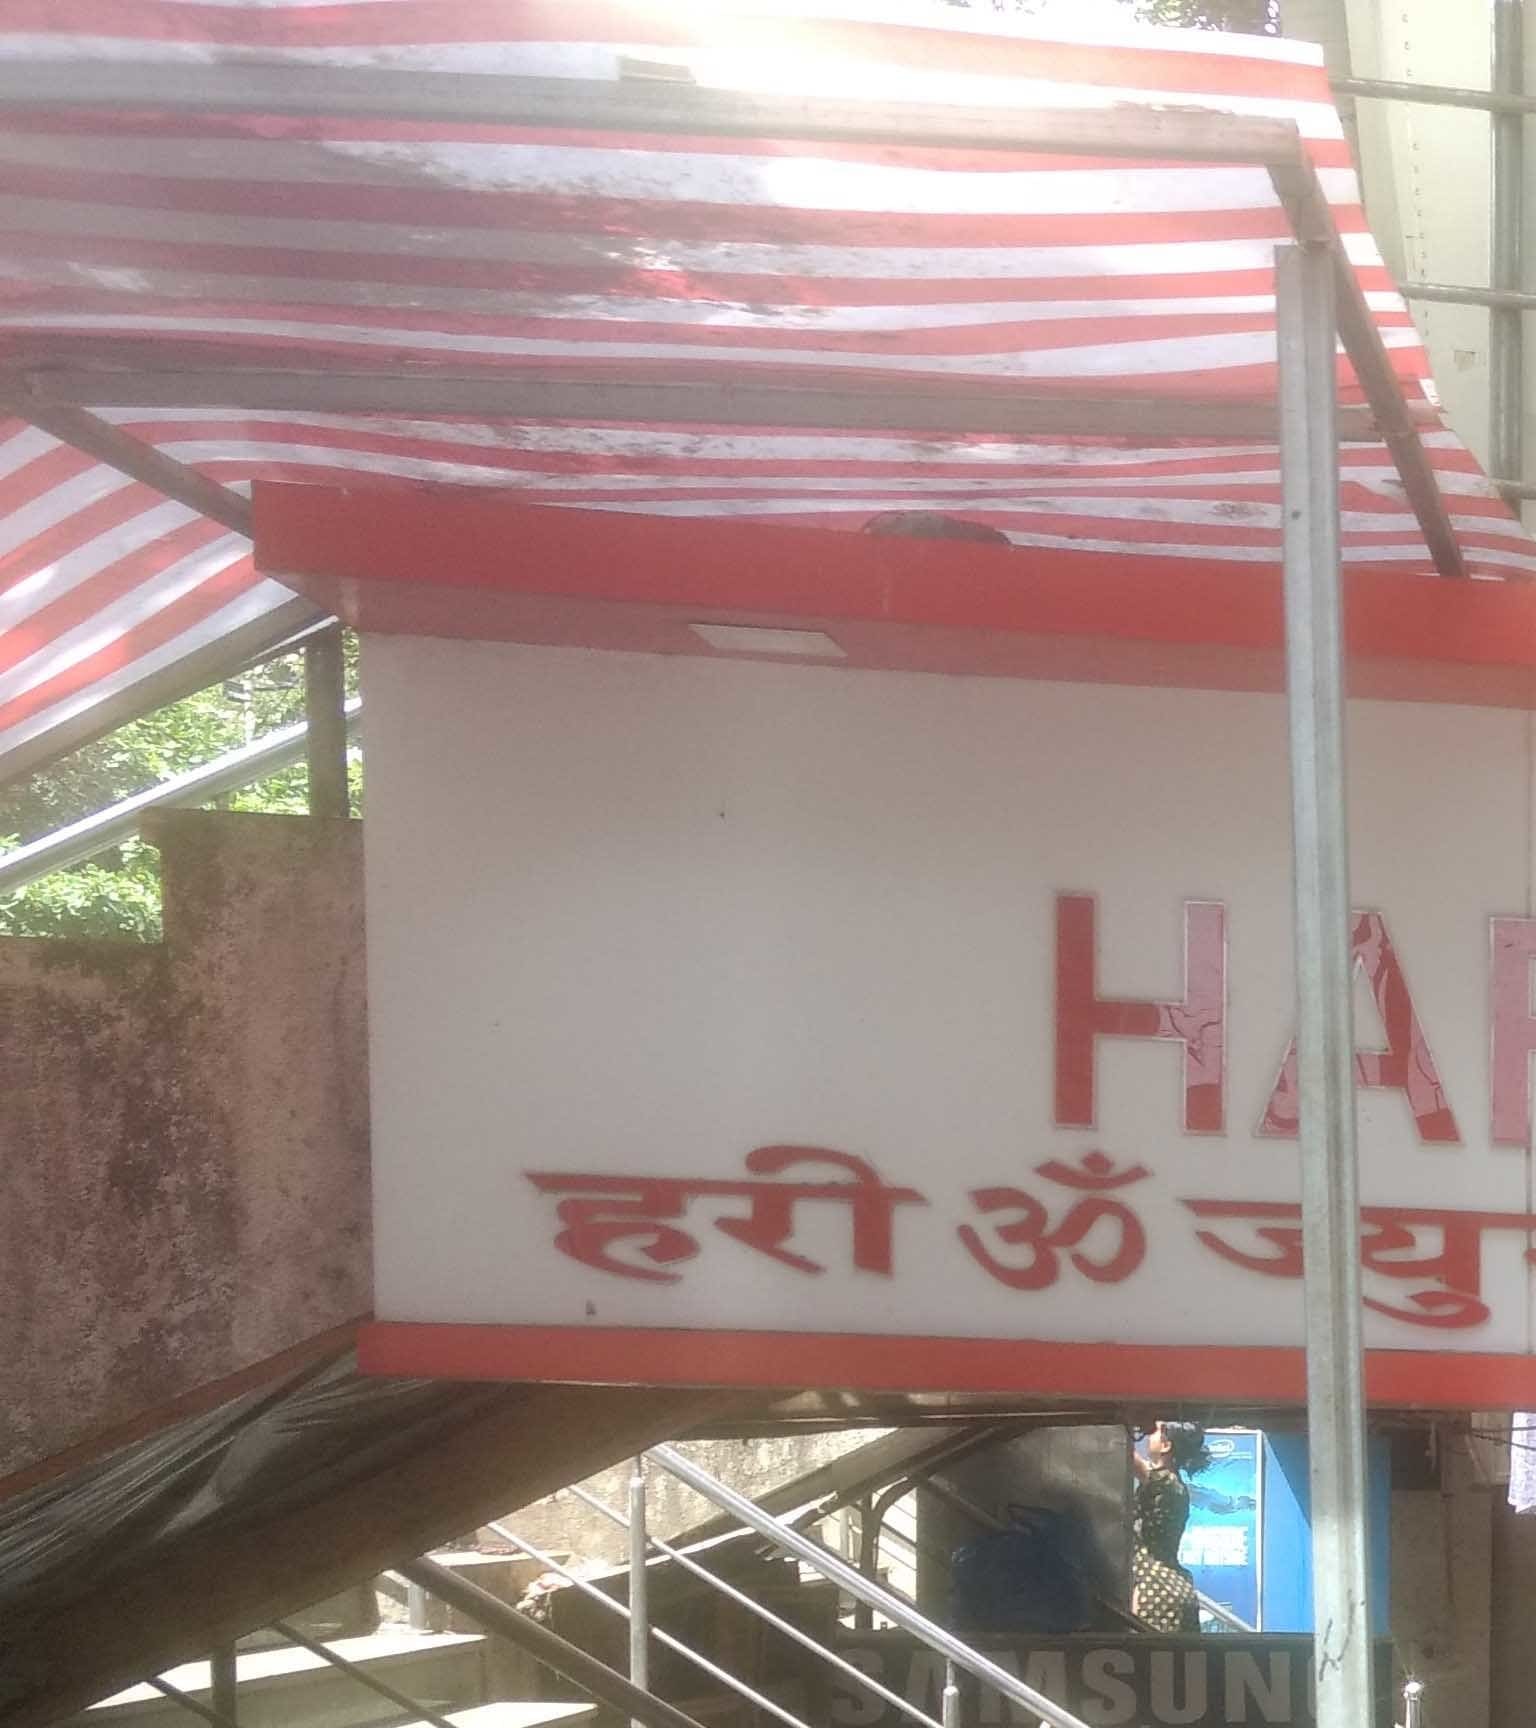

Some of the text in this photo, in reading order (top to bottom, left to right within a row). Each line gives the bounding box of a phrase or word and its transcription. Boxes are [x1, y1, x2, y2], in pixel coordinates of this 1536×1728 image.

[522, 1144, 930, 1285] हरी
[957, 1151, 1152, 1292] ॐ
[831, 1649, 1317, 1727] SAMSUN
